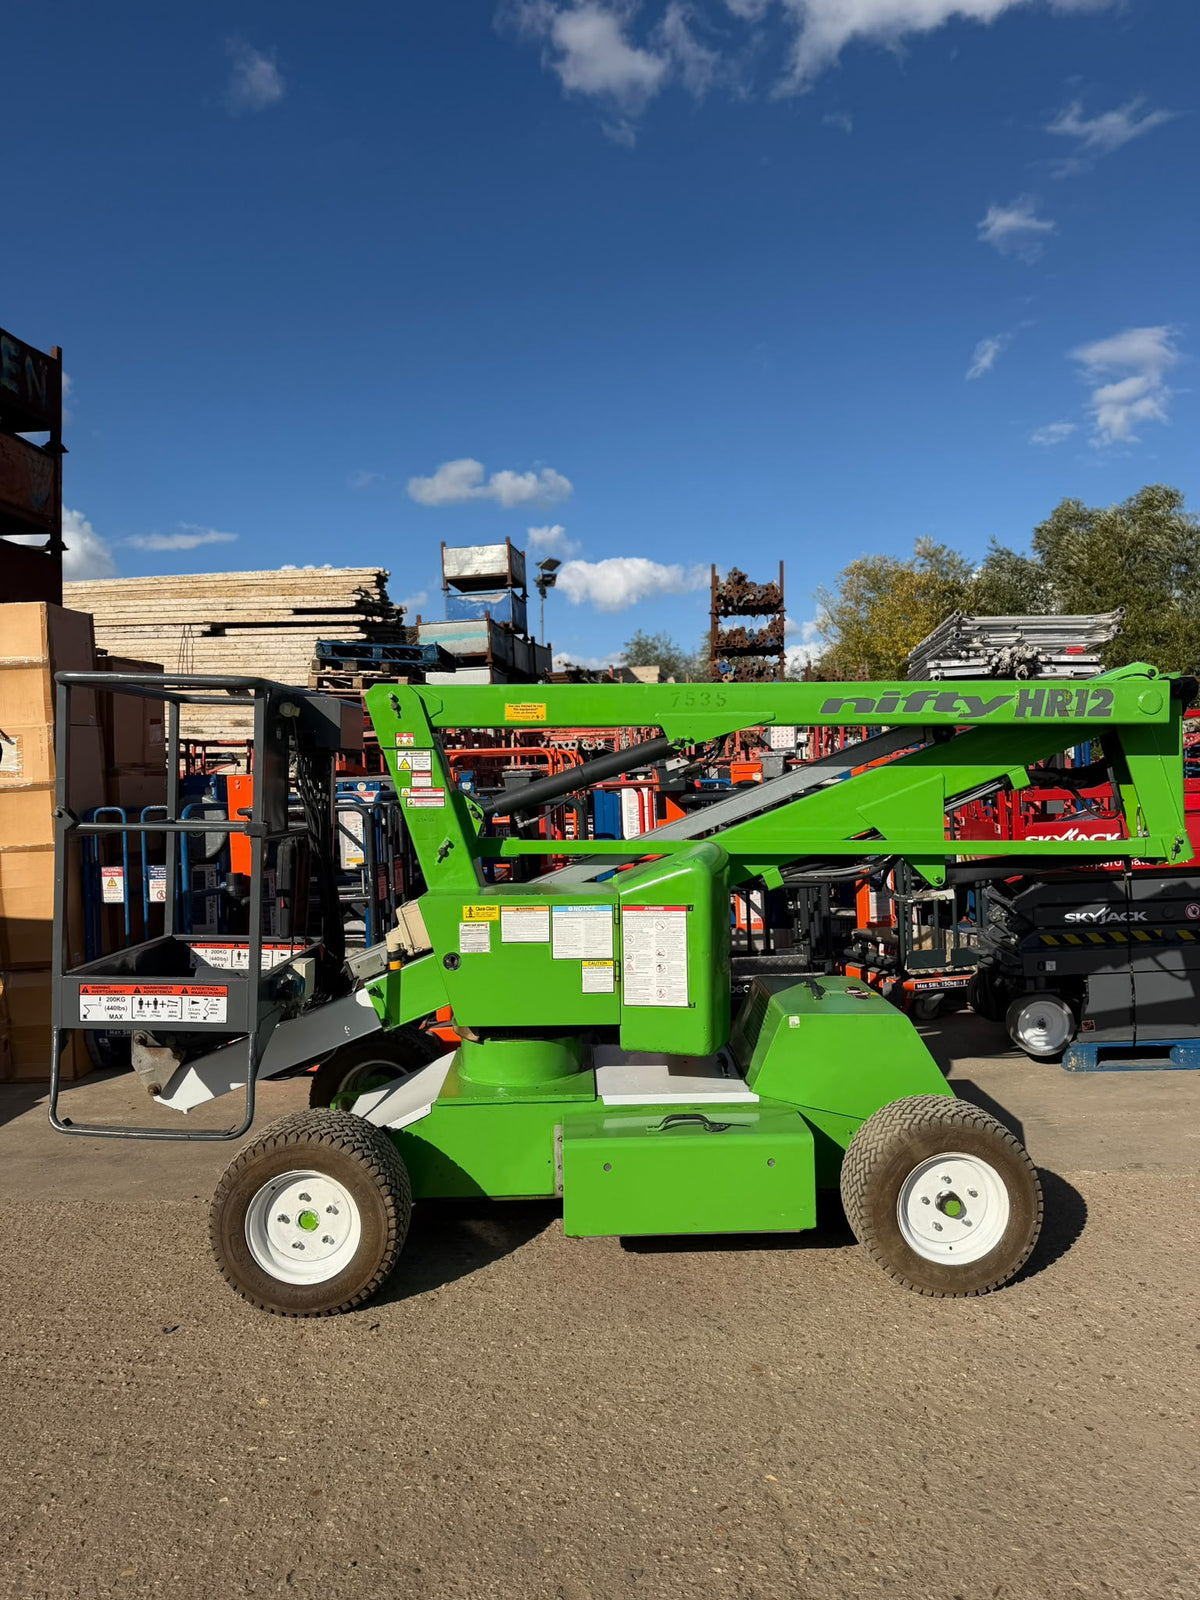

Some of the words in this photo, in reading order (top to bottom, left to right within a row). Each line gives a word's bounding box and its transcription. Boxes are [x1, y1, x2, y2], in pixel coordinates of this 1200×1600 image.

[671, 691, 727, 708] 7535
[820, 690, 1015, 719] nifty
[1015, 689, 1115, 718] HR12
[1064, 906, 1149, 925] SKYJACK
[104, 1005, 128, 1013] (440lbs)
